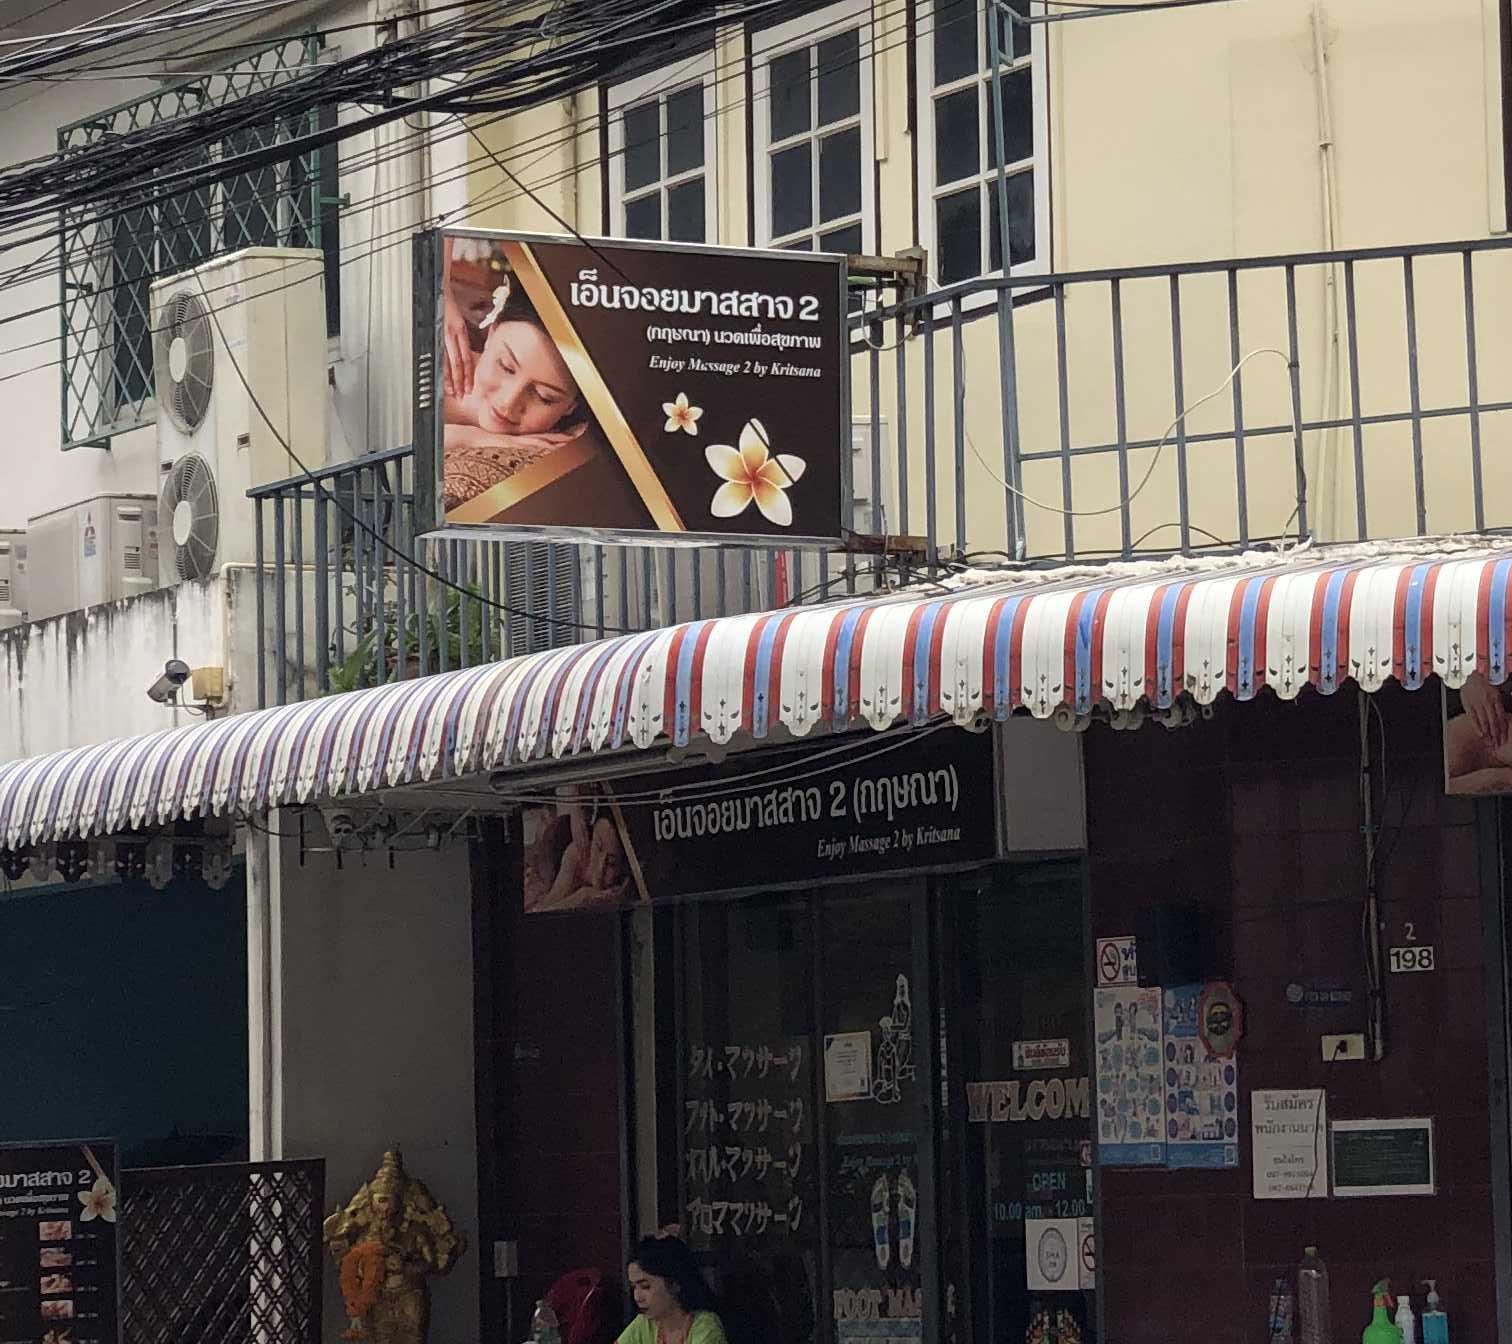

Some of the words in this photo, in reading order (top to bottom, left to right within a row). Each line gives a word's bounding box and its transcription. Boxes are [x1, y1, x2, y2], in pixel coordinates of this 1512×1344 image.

[570, 268, 794, 319] เอ็นจอยมาสสาจ
[799, 296, 819, 321] 2
[714, 324, 822, 349] นวดเพื่อสุขภาพ
[649, 355, 686, 372] Enjoy
[743, 360, 751, 373] 2
[753, 362, 768, 377] by
[770, 362, 822, 378] Kritsana
[829, 780, 848, 817] 2
[852, 763, 959, 824] (กฤษณา)
[817, 838, 847, 860] Enjoy
[901, 828, 915, 852] by
[916, 825, 961, 846] Kritsana
[1404, 922, 1417, 940] 2
[1391, 948, 1433, 969] 198
[78, 1169, 91, 1185] 2
[1031, 1173, 1067, 1192] OPEN
